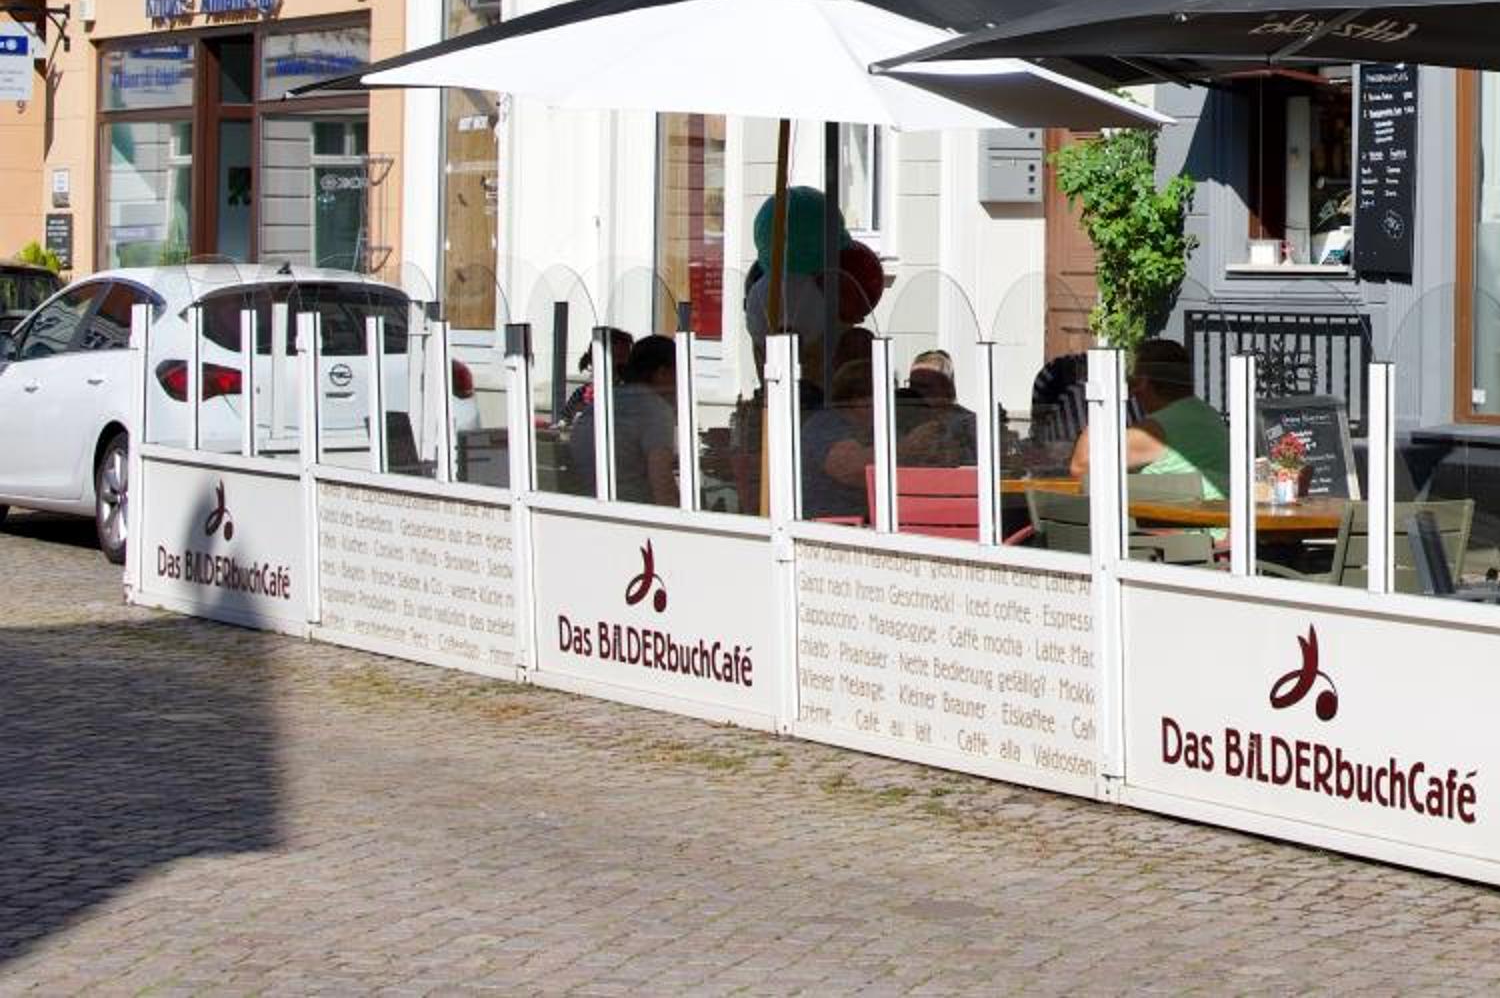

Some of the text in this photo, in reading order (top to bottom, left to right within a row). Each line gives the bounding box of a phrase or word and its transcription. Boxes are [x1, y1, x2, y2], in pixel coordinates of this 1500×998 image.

[158, 546, 180, 579] Das
[993, 597, 1030, 624] coffee
[558, 615, 592, 656] Das
[1035, 637, 1064, 664] Latte
[1162, 716, 1215, 772] Das
